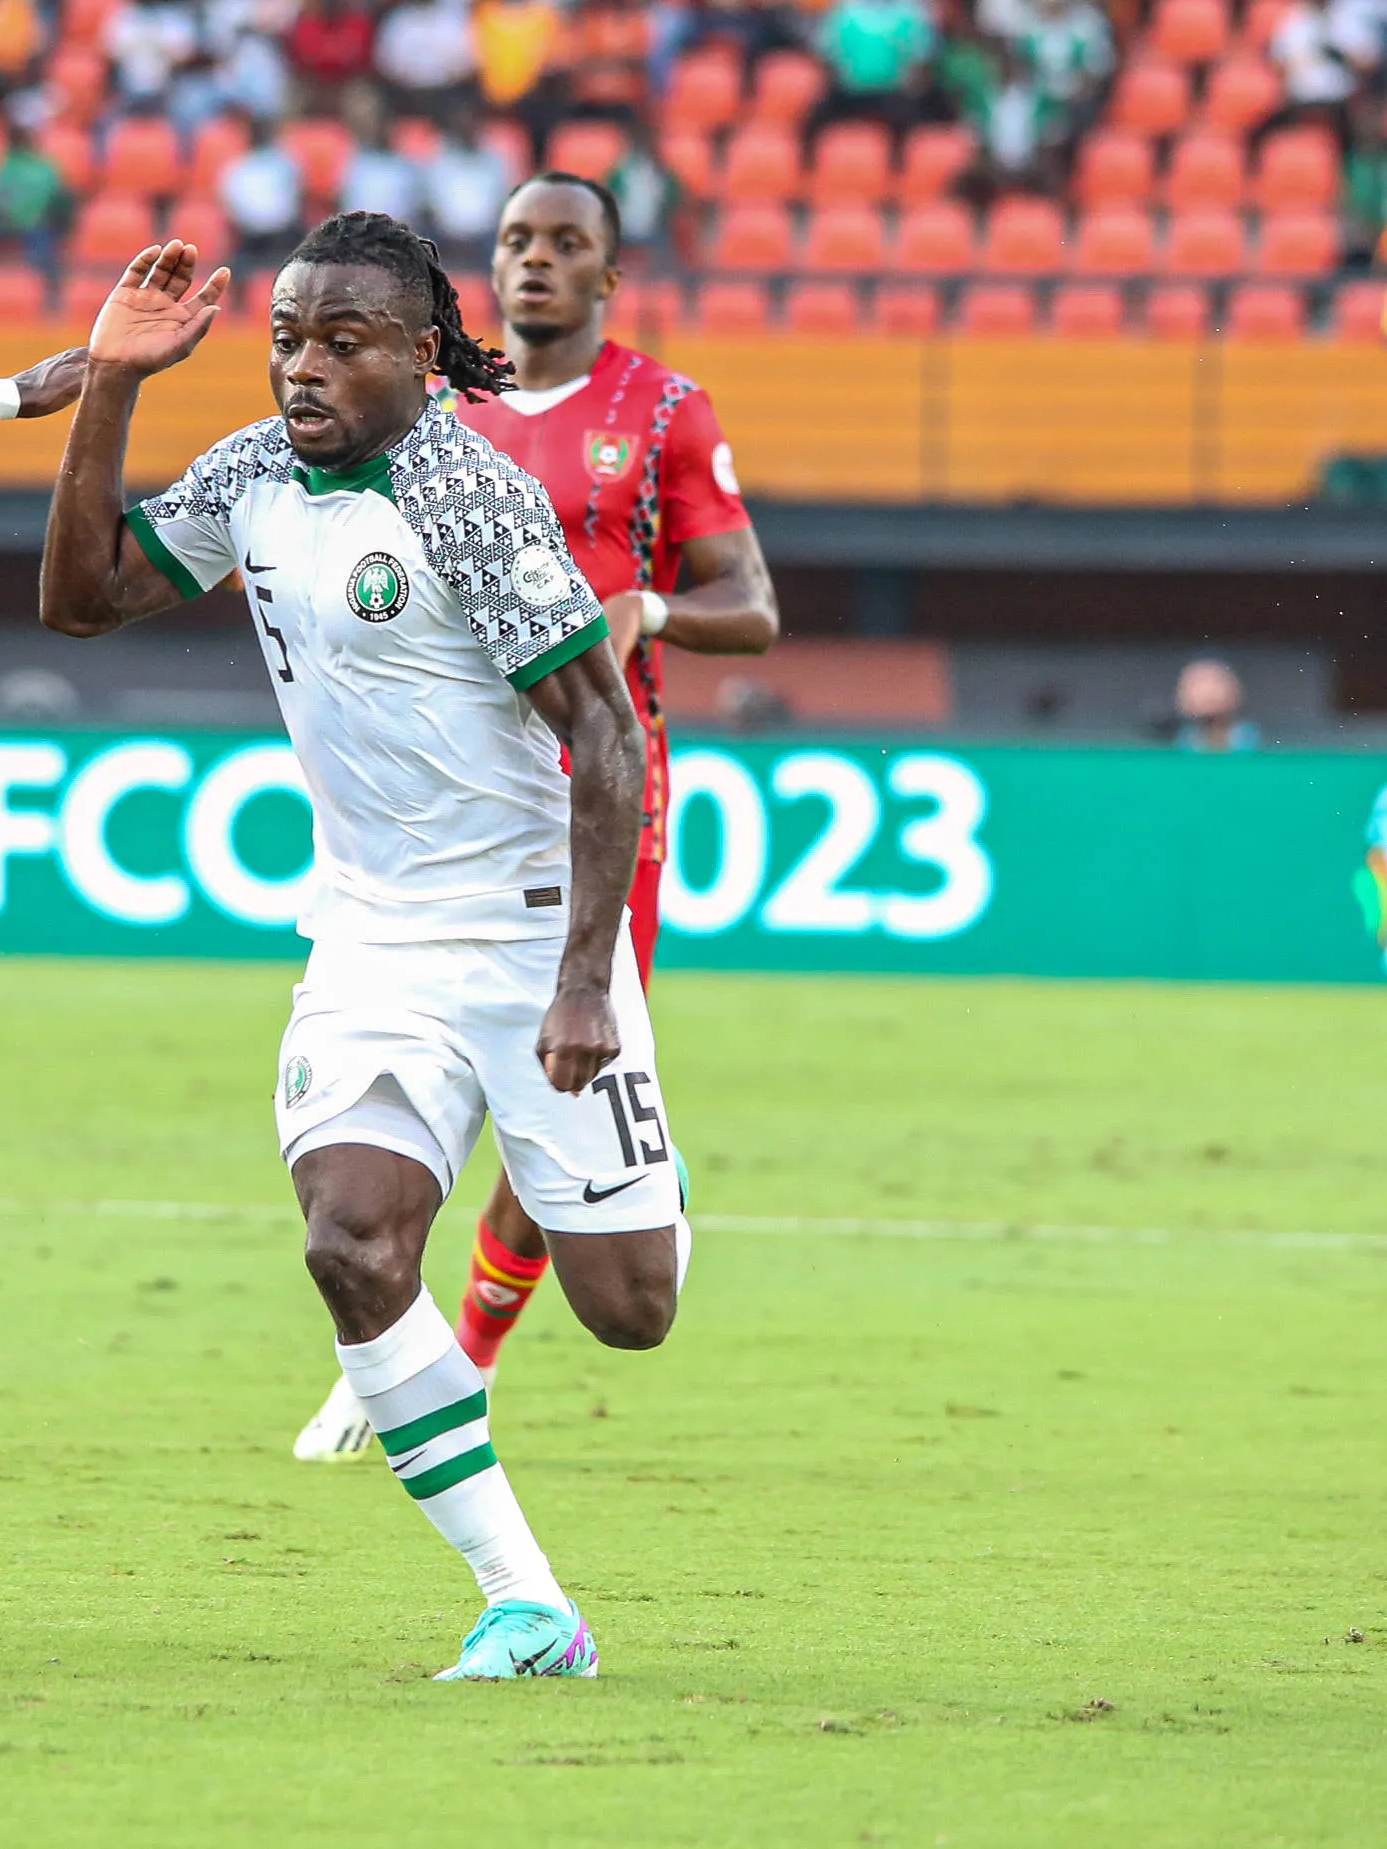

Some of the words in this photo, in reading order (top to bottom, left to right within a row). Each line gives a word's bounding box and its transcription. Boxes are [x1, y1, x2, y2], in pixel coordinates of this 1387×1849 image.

[352, 553, 388, 577] FOOTBALL
[388, 557, 408, 610] FEDERATION
[369, 611, 389, 621] 1945
[658, 747, 998, 942] 023
[591, 1071, 669, 1168] 15
